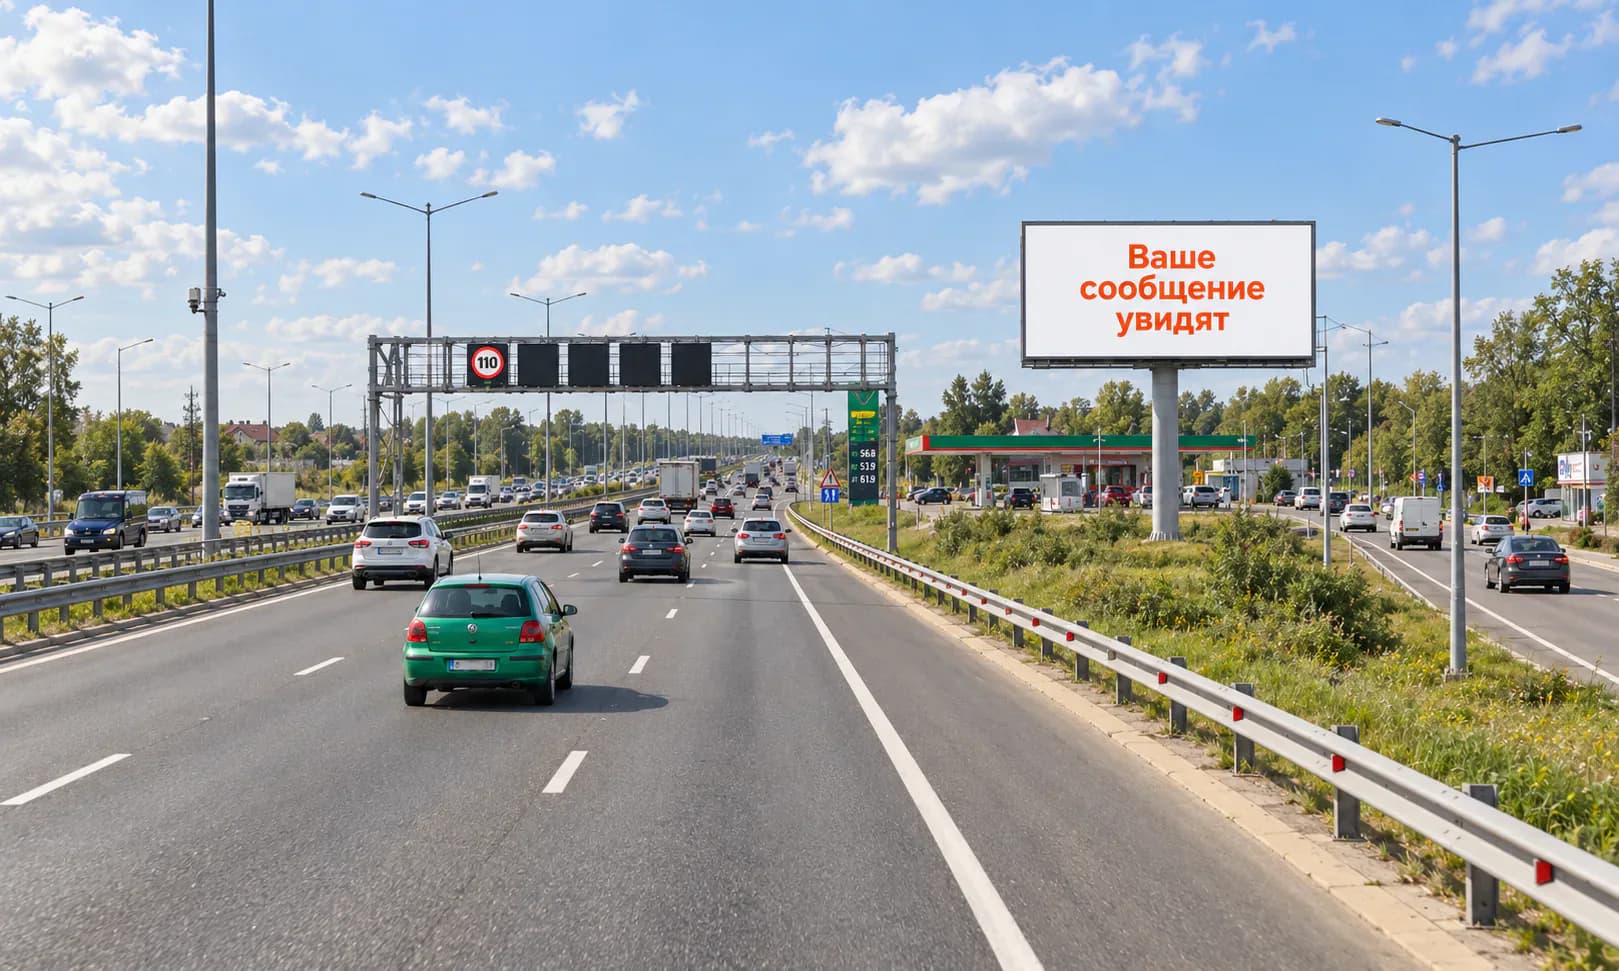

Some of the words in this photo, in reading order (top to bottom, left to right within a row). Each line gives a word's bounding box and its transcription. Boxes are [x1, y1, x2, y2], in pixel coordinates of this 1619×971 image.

[1128, 243, 1217, 270] Ваше
[1079, 274, 1265, 305] сообщение
[1115, 311, 1230, 338] увидят
[477, 356, 498, 369] 110
